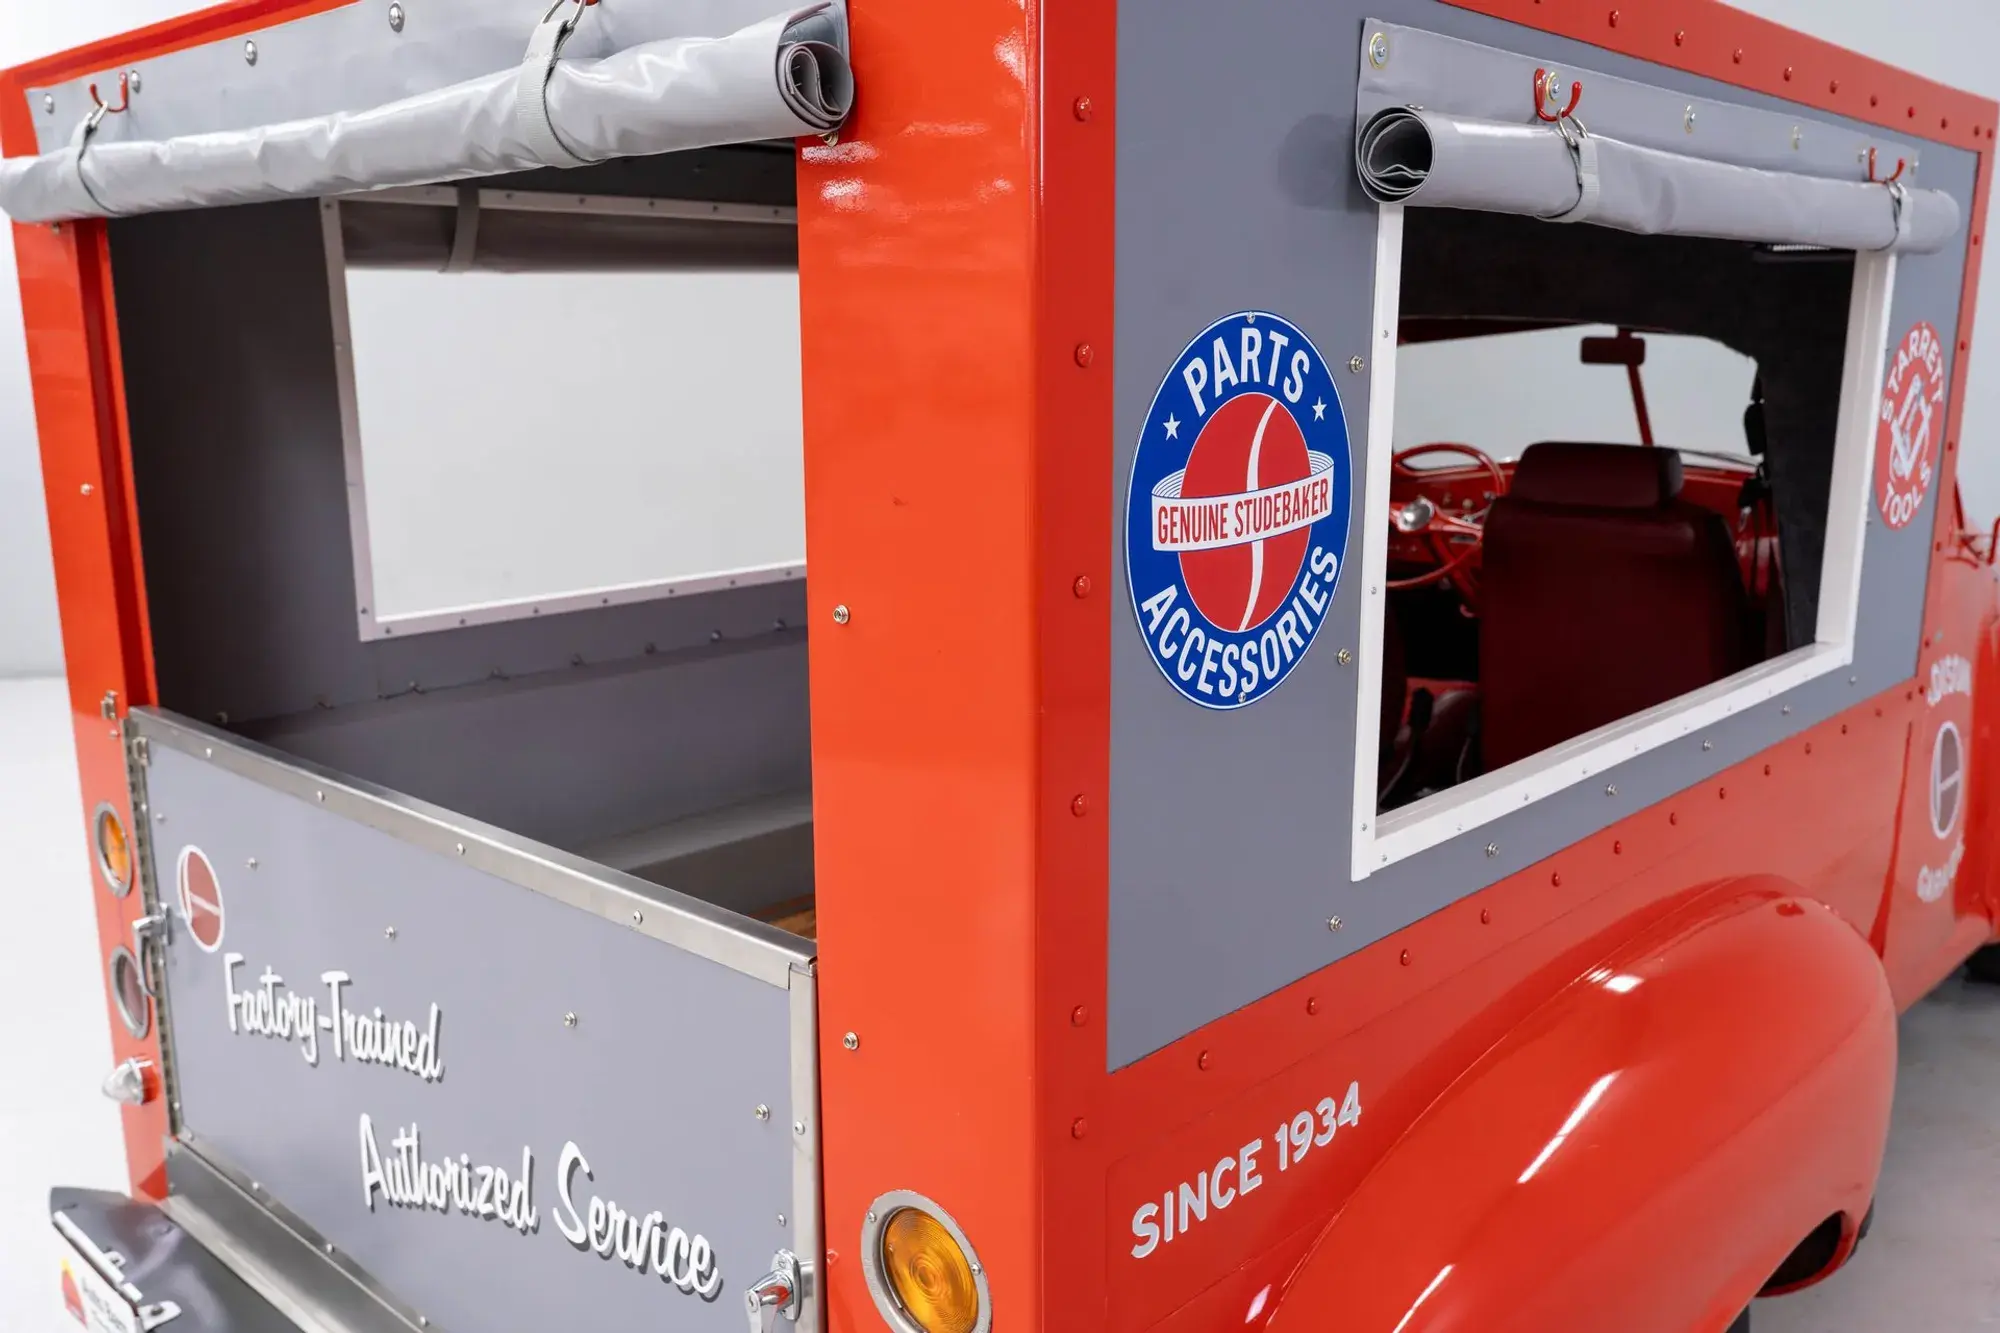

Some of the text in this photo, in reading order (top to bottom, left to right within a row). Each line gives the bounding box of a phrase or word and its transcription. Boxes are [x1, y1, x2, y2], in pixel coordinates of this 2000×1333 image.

[1182, 327, 1310, 417] PARTS
[1157, 477, 1329, 545] GENUINE STUDEBAKER
[1882, 459, 1931, 524] TOOLS
[1140, 545, 1338, 698] ACCESSORIES
[224, 952, 444, 1080] Factory-Trained
[358, 1112, 722, 1301] Authorized Service
[1131, 1080, 1362, 1259] SINCE 1934
